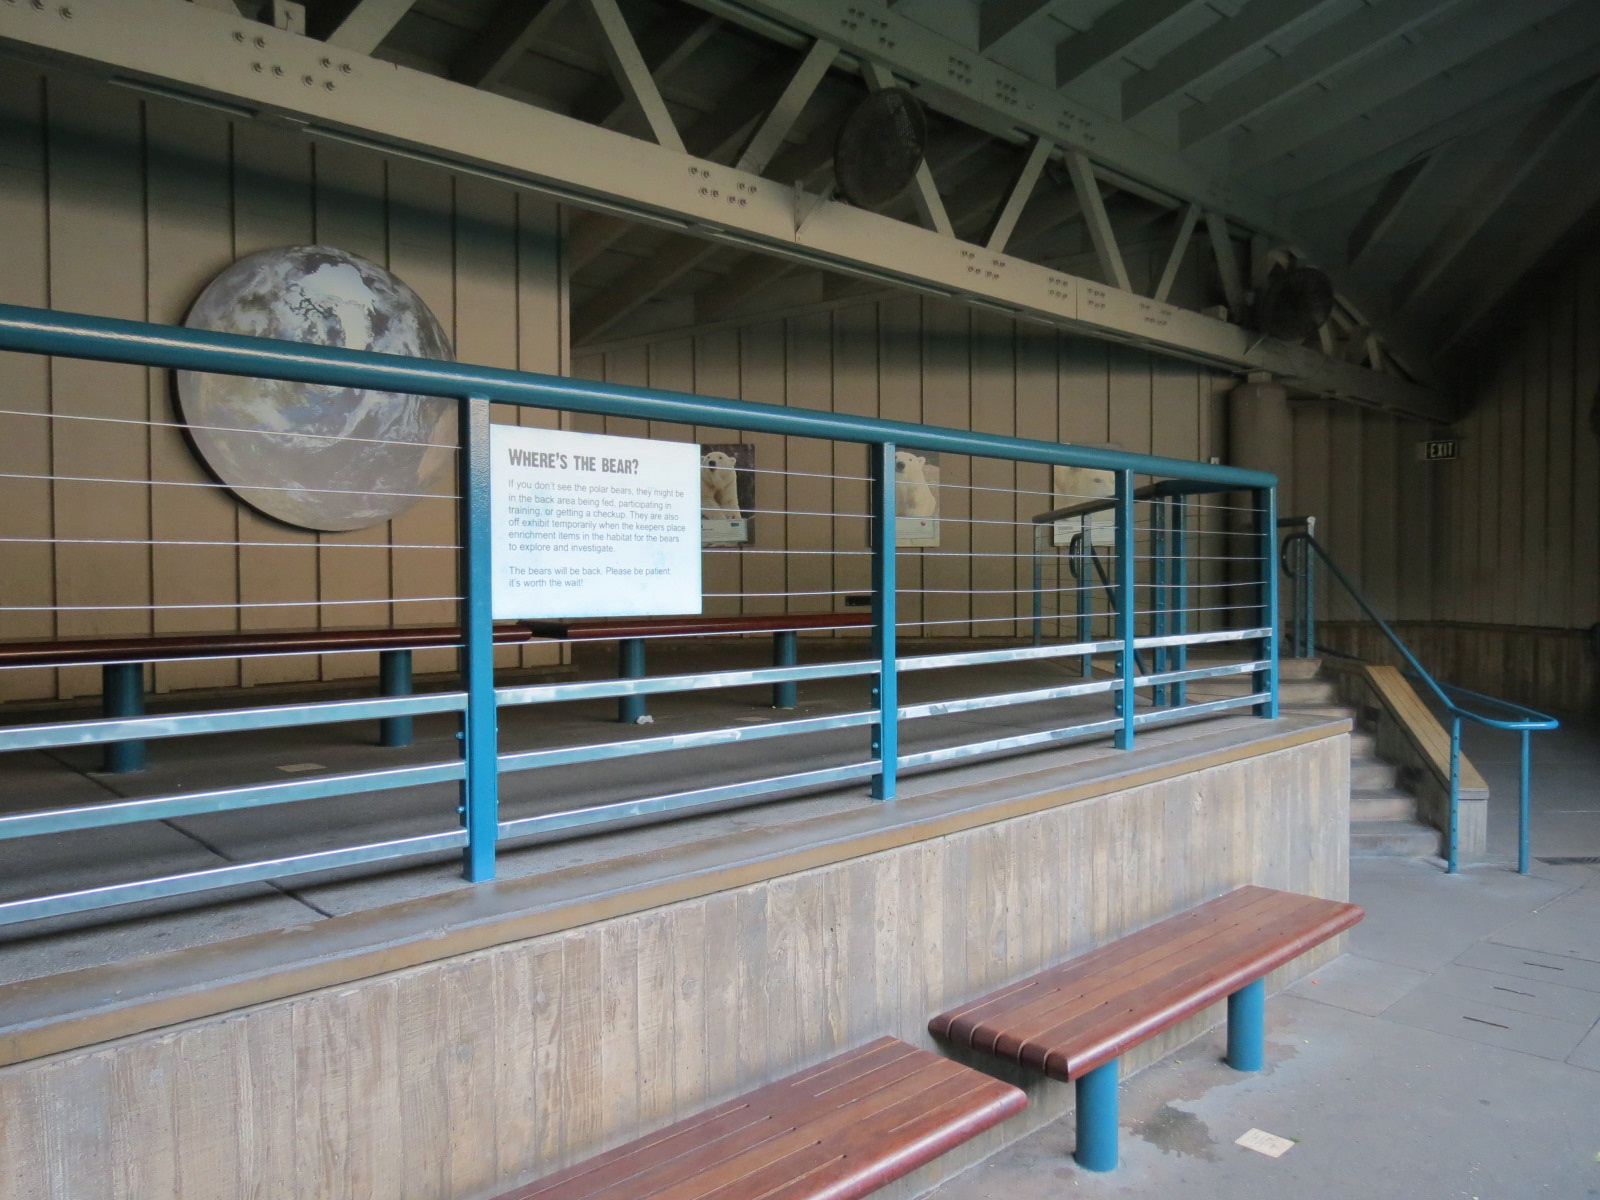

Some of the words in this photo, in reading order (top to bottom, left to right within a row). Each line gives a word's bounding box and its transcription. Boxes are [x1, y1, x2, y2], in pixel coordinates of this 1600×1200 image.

[1430, 442, 1453, 458] EXIT
[508, 448, 568, 470] WHERE'S
[573, 455, 596, 472] THE
[602, 457, 639, 475] BEAR?
[508, 479, 514, 488] If
[516, 481, 532, 490] you
[534, 481, 555, 490] don't
[574, 484, 587, 492] the
[589, 485, 608, 494] polar
[611, 486, 634, 495] bears,
[636, 487, 651, 497] they
[654, 489, 673, 498] might
[508, 493, 516, 502] in
[519, 494, 532, 503] the
[535, 495, 554, 504] back
[578, 498, 600, 507] being
[602, 498, 616, 507] fed,
[618, 500, 663, 511] participating
[508, 506, 542, 517] training,
[556, 508, 583, 518] getting
[630, 511, 648, 521] They
[664, 513, 679, 521] also
[508, 518, 519, 526] off
[522, 519, 550, 527] exhibit
[552, 520, 597, 530] temporarily
[599, 521, 619, 530] when
[622, 522, 633, 530] the
[636, 522, 664, 532] keepers
[666, 524, 686, 533] place
[508, 530, 556, 539] enrichment
[558, 531, 580, 540] items
[583, 532, 589, 540] in
[592, 533, 604, 541] the
[606, 533, 632, 541] habitat
[634, 534, 644, 542] for
[646, 534, 658, 542] the
[659, 534, 680, 542] bears
[508, 543, 517, 551] to
[520, 543, 551, 552] explore
[553, 543, 569, 552] and
[571, 543, 615, 554] investigate.
[509, 566, 526, 575] The
[528, 566, 552, 575] bears
[554, 566, 567, 575] will
[569, 566, 580, 575] be
[605, 566, 632, 575] Please
[634, 567, 643, 575] be
[509, 579, 521, 587] it's
[523, 579, 546, 587] worth
[549, 579, 562, 587] the
[565, 579, 583, 587] wait!
